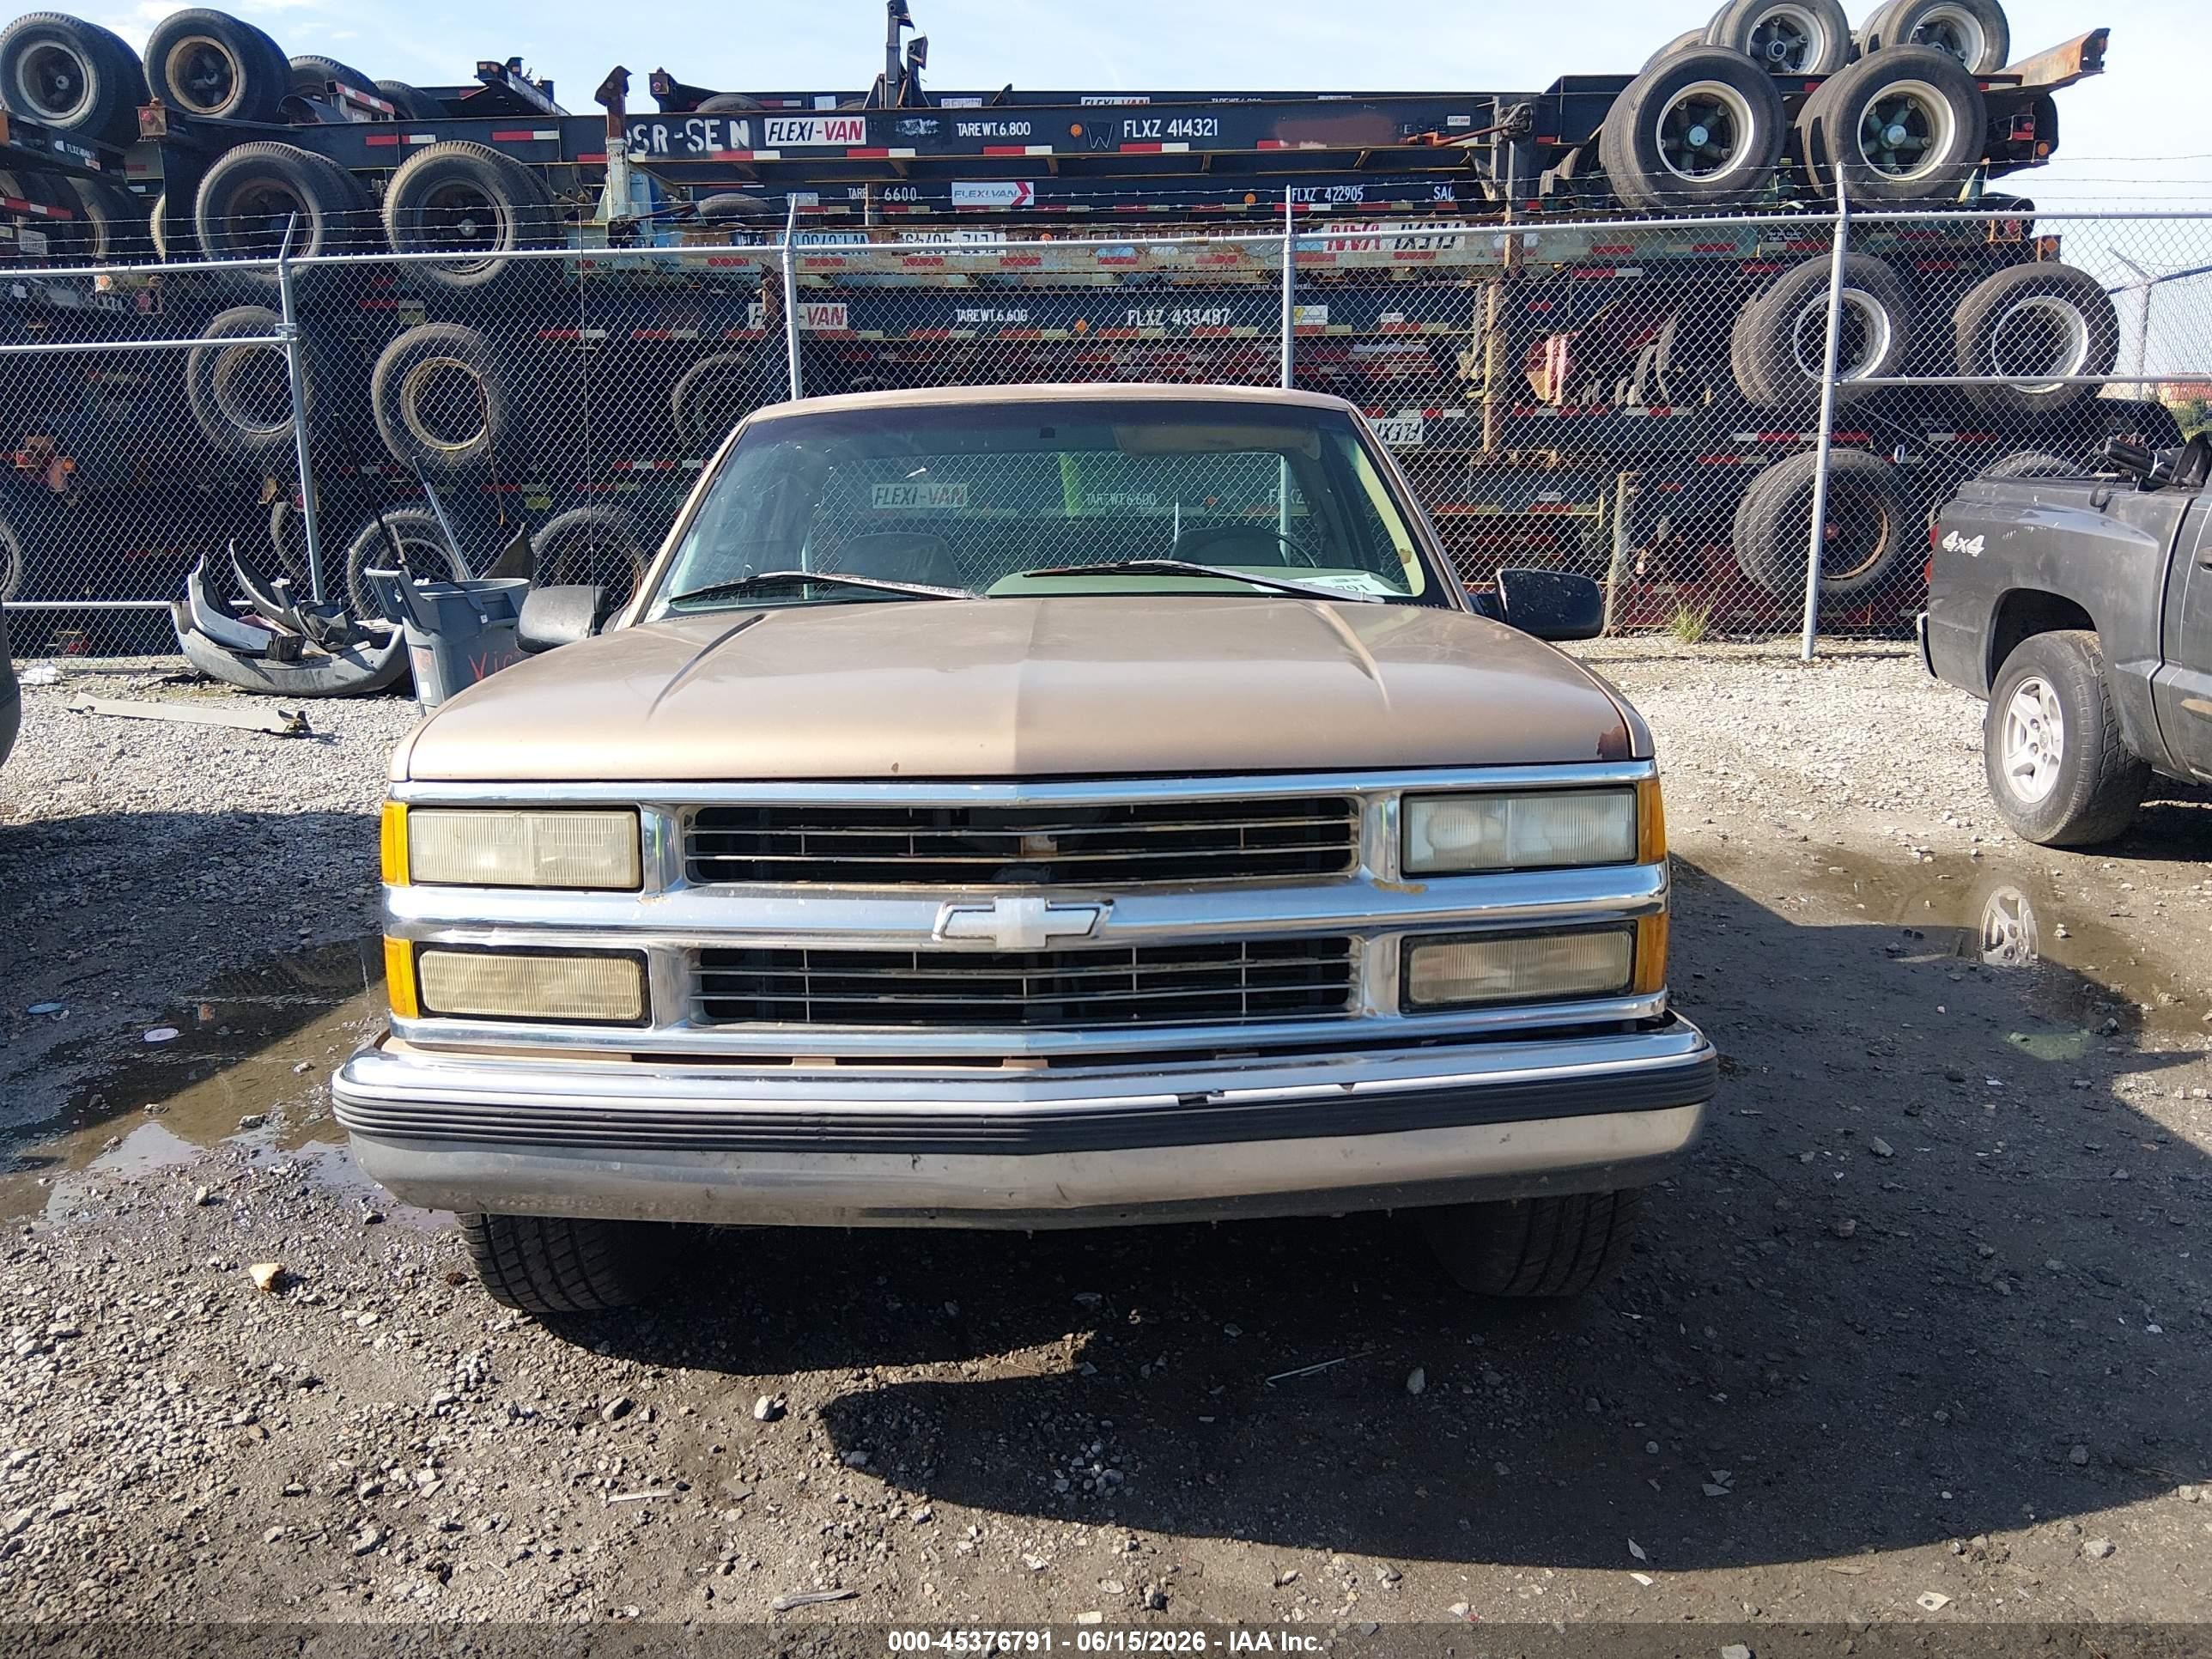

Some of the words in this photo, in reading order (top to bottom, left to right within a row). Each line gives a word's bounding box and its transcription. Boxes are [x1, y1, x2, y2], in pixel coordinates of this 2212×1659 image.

[768, 121, 863, 143] FLEXI-VAN
[1123, 119, 1162, 137] FLXZ
[1167, 118, 1218, 137] 414321
[884, 187, 917, 202] 6600
[1291, 188, 1316, 202] FLXZ
[1324, 186, 1364, 201] 422905
[1127, 309, 1164, 327] FLXZ
[874, 487, 966, 505] FLEXI-VAN
[1942, 530, 1985, 556] 4x4
